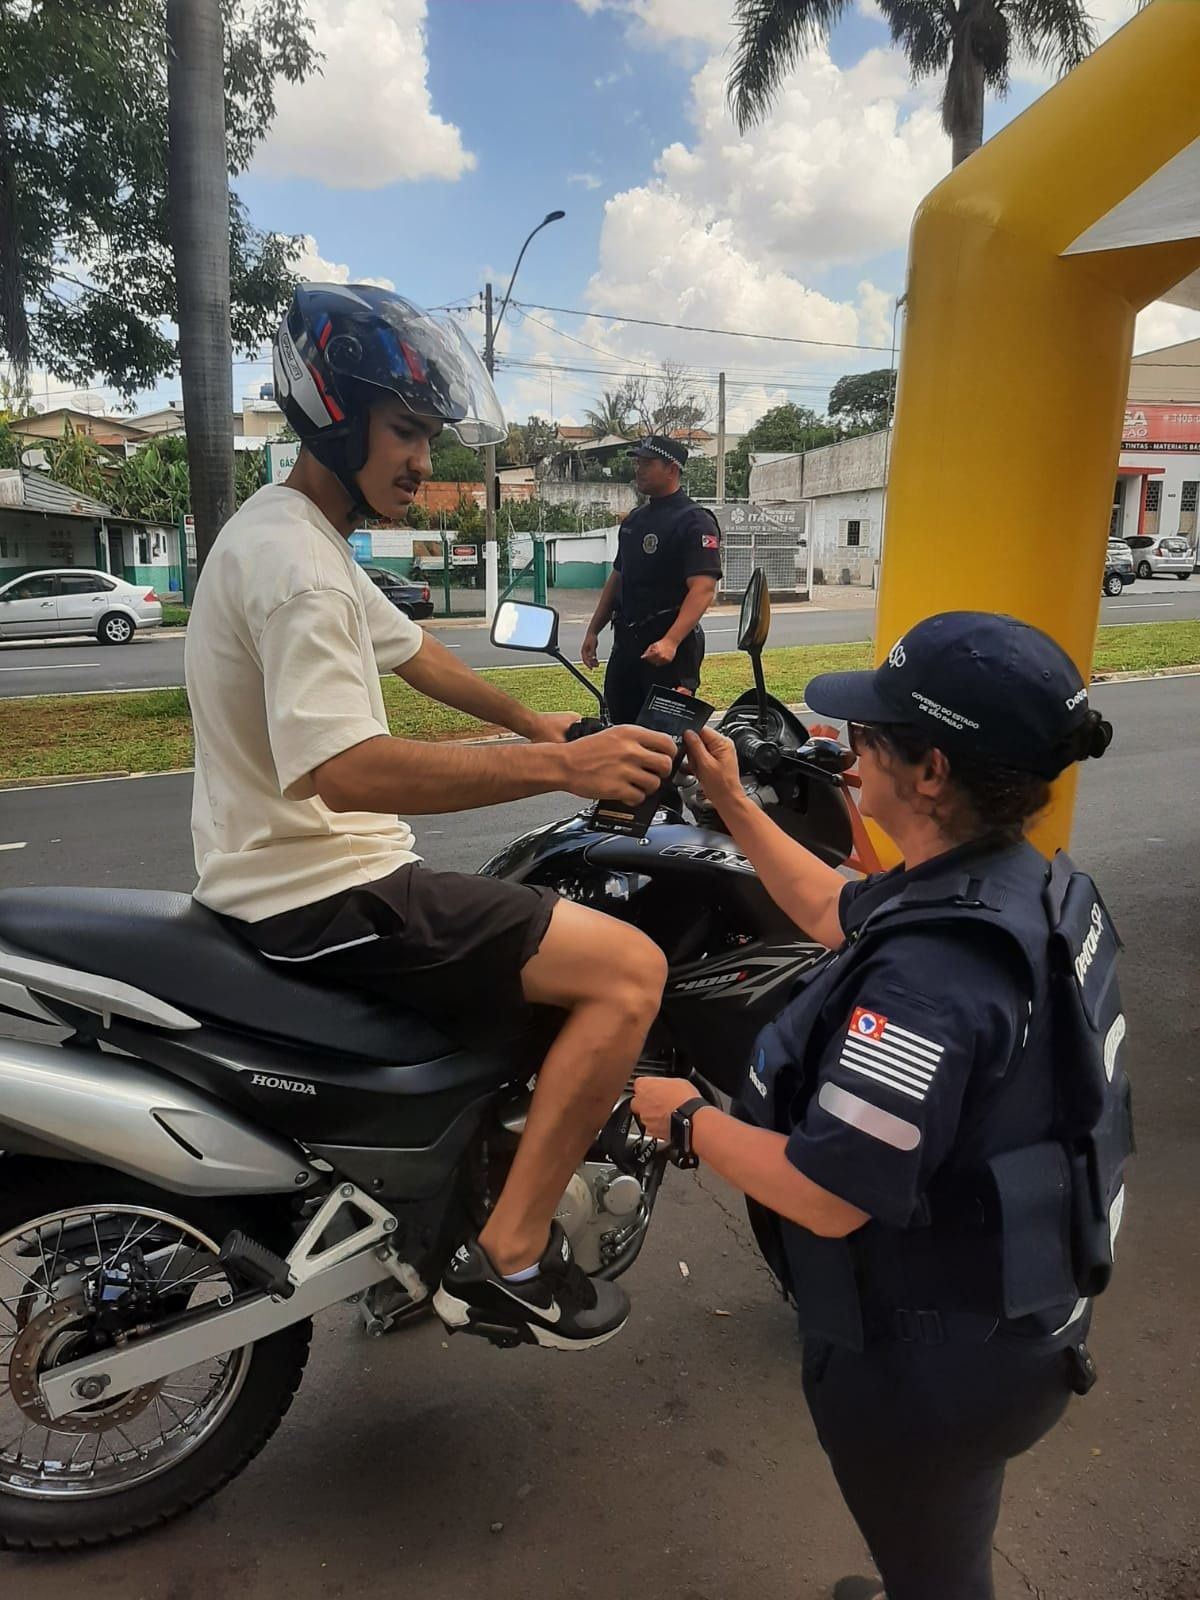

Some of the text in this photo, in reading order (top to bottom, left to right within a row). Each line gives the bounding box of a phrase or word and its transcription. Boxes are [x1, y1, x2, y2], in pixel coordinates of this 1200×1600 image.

[911, 691, 979, 729] GOVERNO DO ESTADO
[918, 703, 963, 730] DE SÃO PAULO
[250, 1074, 317, 1095] HONDA
